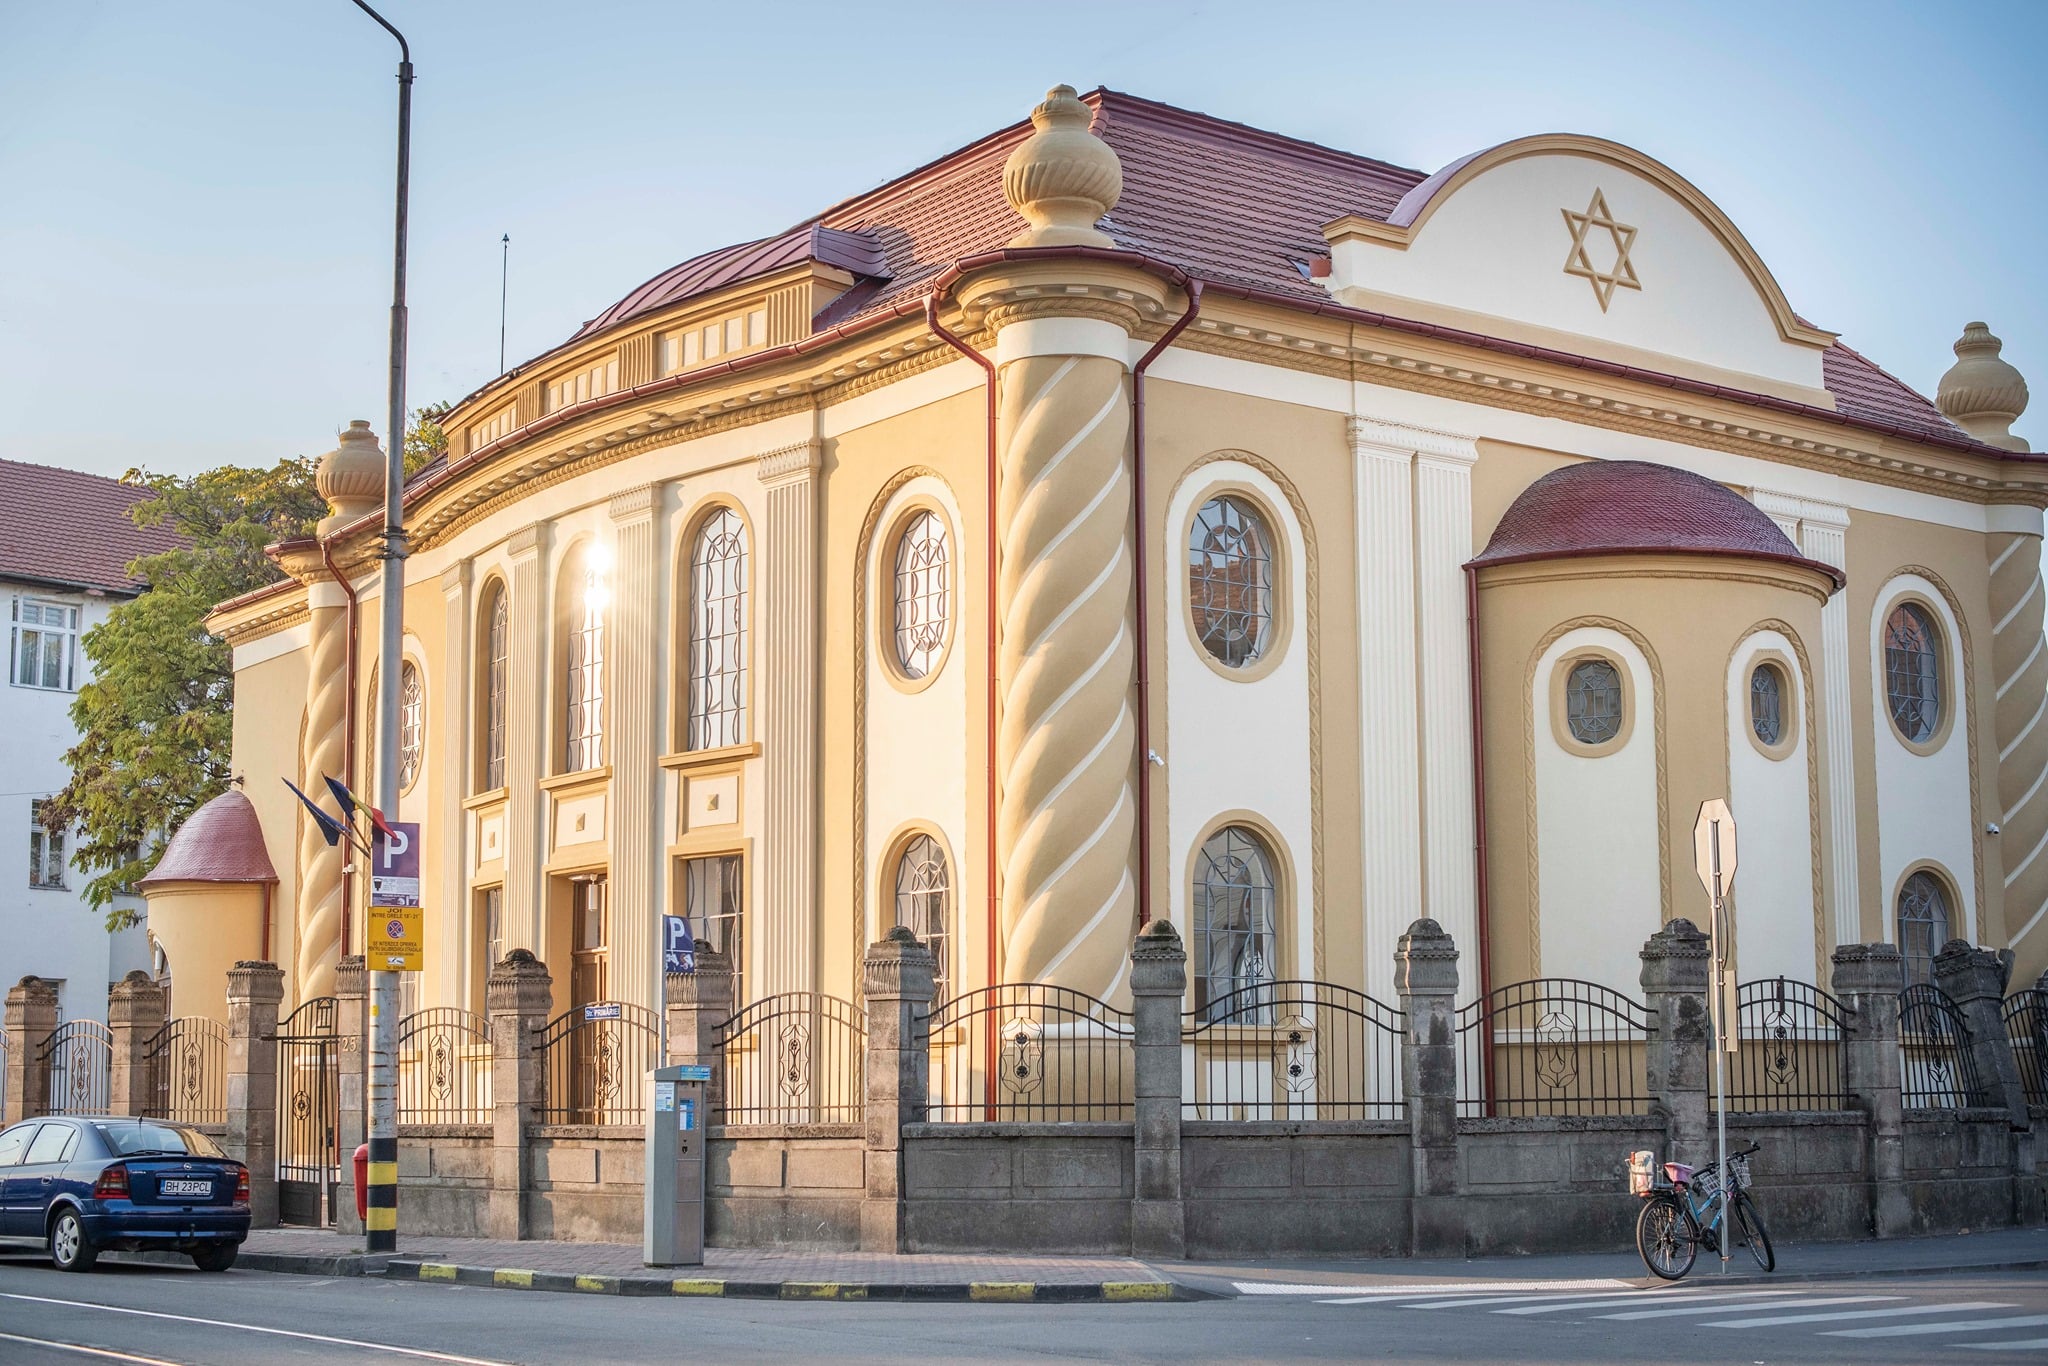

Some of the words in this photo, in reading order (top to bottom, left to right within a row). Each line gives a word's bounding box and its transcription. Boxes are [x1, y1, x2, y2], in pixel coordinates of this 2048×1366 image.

[384, 831, 408, 868] P
[669, 917, 685, 949] P
[342, 1036, 357, 1052] 25
[165, 1182, 179, 1191] BH
